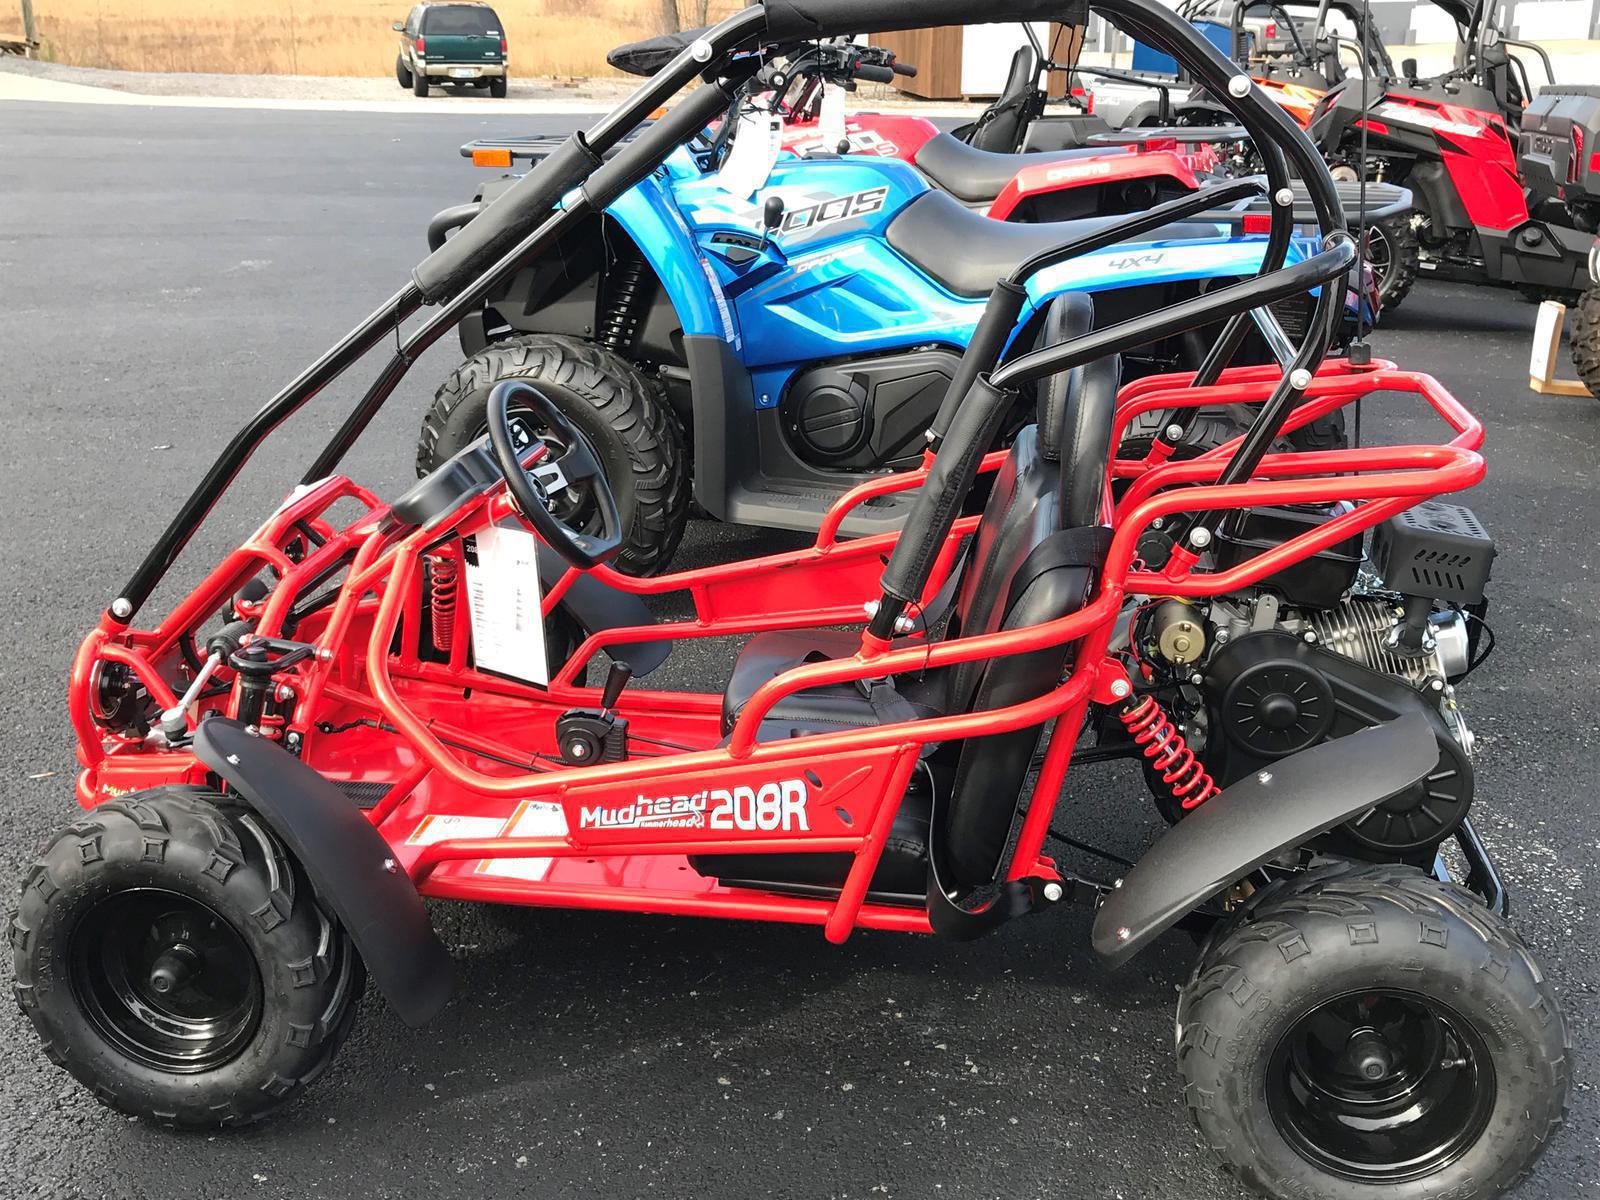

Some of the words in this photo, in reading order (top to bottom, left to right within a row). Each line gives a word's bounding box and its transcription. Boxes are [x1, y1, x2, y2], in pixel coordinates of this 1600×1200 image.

[756, 187, 888, 237] 00S
[579, 790, 708, 829] Mudhead
[710, 779, 811, 832] 208R
